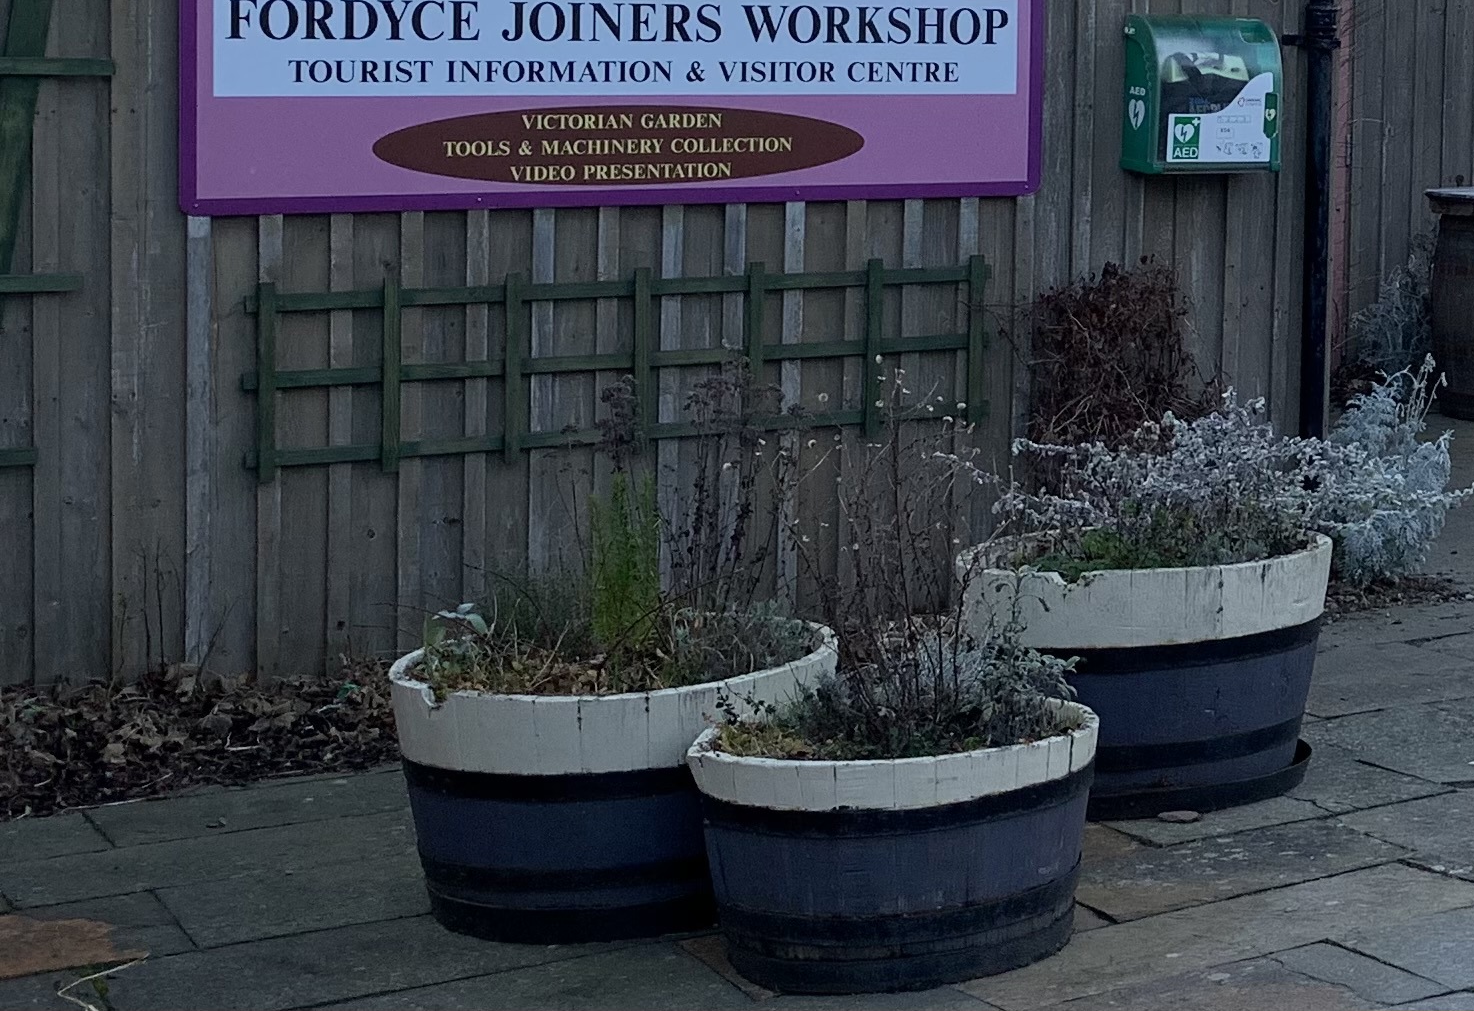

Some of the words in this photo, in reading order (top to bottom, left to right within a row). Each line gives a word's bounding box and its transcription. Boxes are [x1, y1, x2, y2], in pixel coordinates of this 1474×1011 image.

[501, 0, 722, 43] JOINERS
[740, 3, 1009, 47] WORKSHOP
[288, 58, 434, 84] TOURIST
[446, 59, 673, 84] INFORMATION
[685, 60, 706, 83] &
[718, 61, 836, 84] VISITOR
[847, 61, 960, 84] CENTRE
[1129, 85, 1146, 97] AED
[521, 113, 633, 131] VICTORIAN
[640, 112, 722, 129] GARDEN
[443, 139, 511, 158] TOOLS
[518, 140, 533, 157] &
[541, 139, 664, 156] MACHINERY
[670, 136, 793, 155] COLLECTION
[1173, 146, 1198, 158] AED
[509, 164, 576, 182] VIDEO
[583, 162, 733, 181] PRESENTATION
